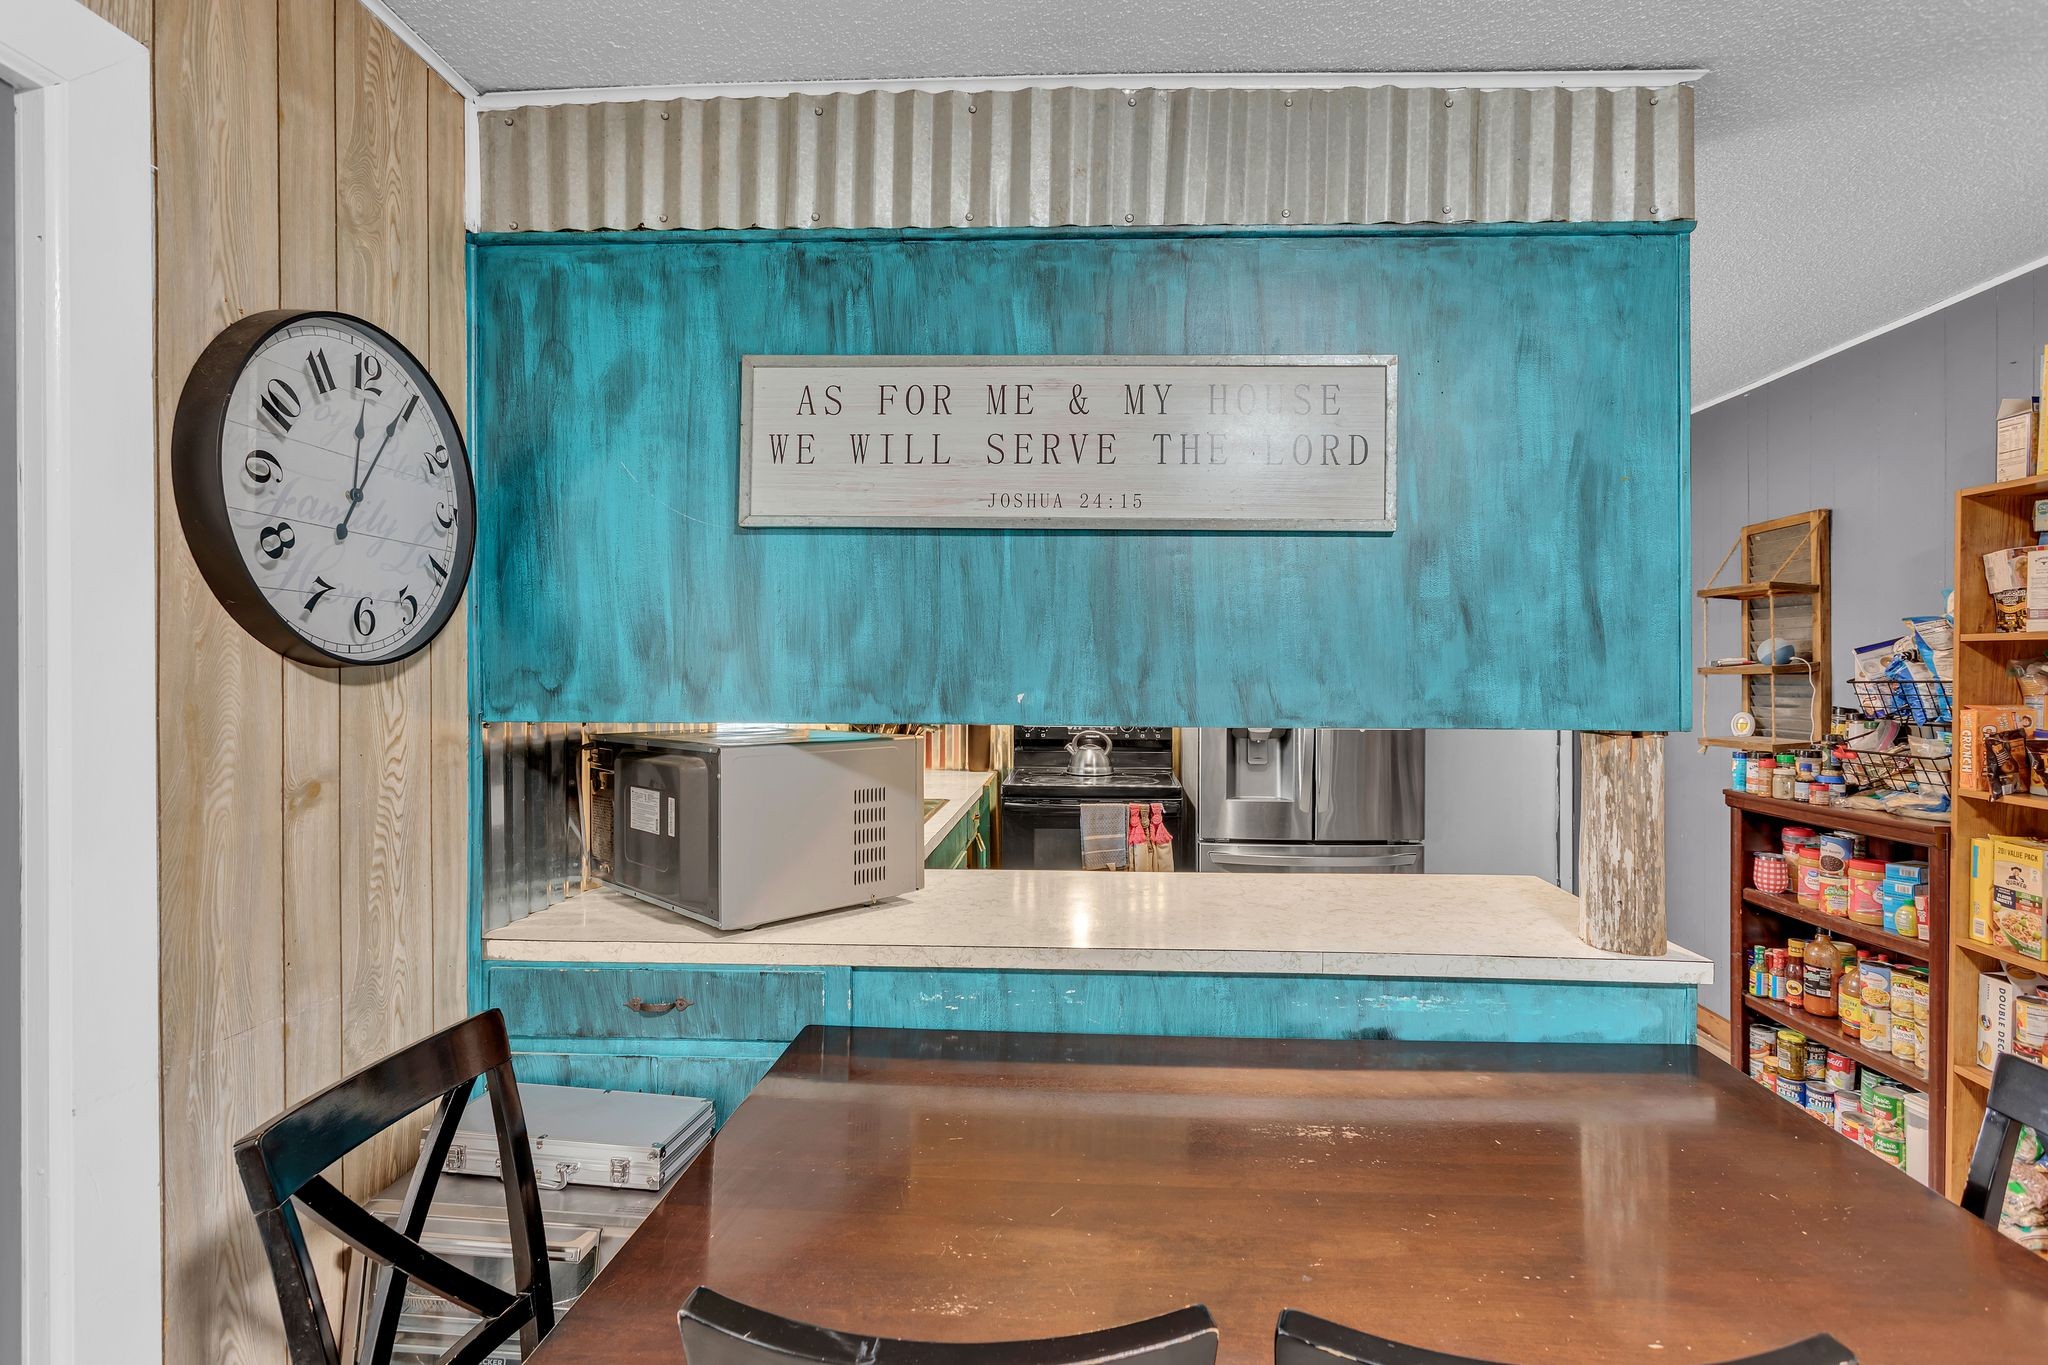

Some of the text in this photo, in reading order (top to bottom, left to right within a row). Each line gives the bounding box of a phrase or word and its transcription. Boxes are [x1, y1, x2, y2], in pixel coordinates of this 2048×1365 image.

[306, 347, 337, 395] 11
[353, 351, 383, 397] 12
[259, 378, 302, 433] 10
[401, 394, 420, 423] 1
[796, 383, 1342, 416] AS FOR ME & MY HOUSE
[244, 449, 284, 484] 9
[423, 445, 449, 476] 2
[769, 432, 1369, 466] WE WILL SERVE THE LORD
[987, 490, 1143, 509] JOSHUA 24:15
[259, 522, 296, 560] 8
[303, 576, 337, 614] 7
[398, 585, 419, 626] 5
[353, 596, 377, 637] 6
[1961, 729, 1973, 774] CRUNCH
[2007, 849, 2023, 860] VALUE
[2024, 852, 2039, 863] PACK
[1998, 987, 2006, 1028] DOUBLE
[1809, 1098, 1832, 1109] Chili
